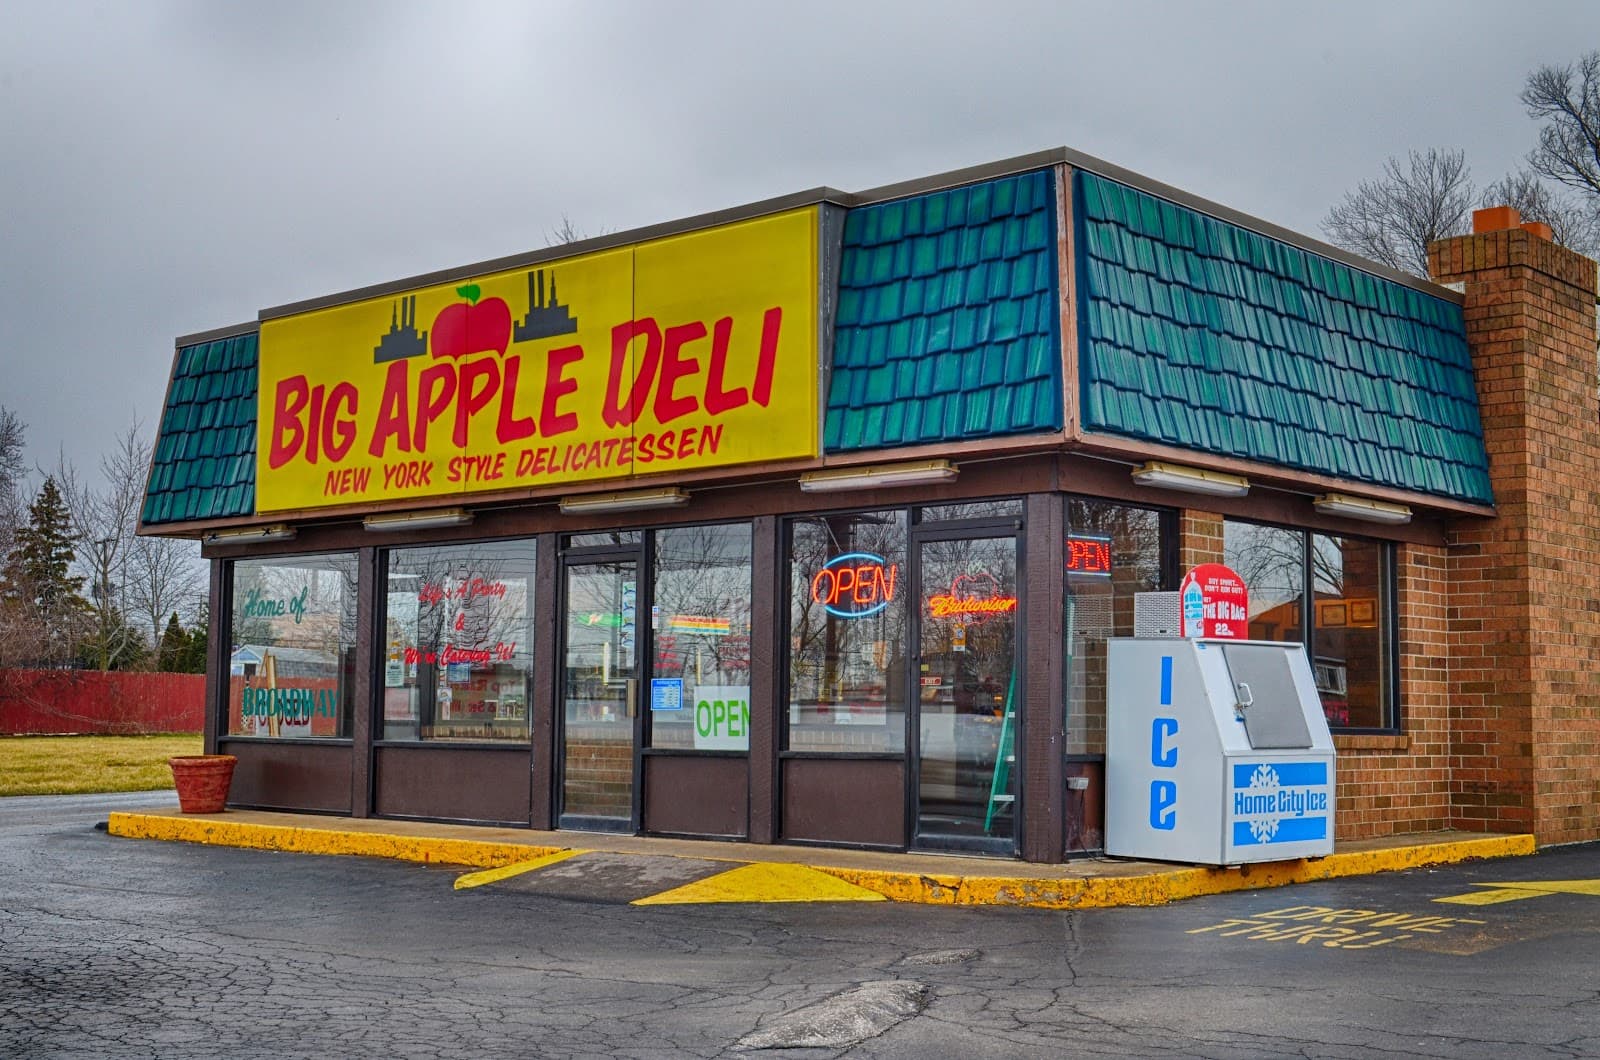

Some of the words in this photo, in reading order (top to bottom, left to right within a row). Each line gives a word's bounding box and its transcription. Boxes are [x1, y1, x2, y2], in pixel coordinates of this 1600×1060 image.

[268, 374, 359, 471] BIG
[368, 344, 585, 459] APPLE
[601, 306, 783, 430] DELI
[324, 467, 371, 497] NEW
[384, 460, 434, 490] YORK
[447, 452, 507, 483] STYLE
[515, 424, 724, 478] DELICATESSEN
[812, 564, 897, 605] OPEN
[244, 587, 286, 618] Home
[290, 585, 308, 625] of
[930, 594, 1017, 617] Budweiser
[1203, 602, 1217, 619] THE
[1217, 601, 1230, 620] BIG
[1230, 602, 1246, 621] BAG
[243, 687, 340, 718] BROADWAY
[1234, 792, 1276, 816] Home
[1278, 789, 1305, 817] City
[1306, 789, 1327, 811] Ice
[1184, 919, 1414, 950] THRU
[1250, 905, 1488, 934] DRIVE
